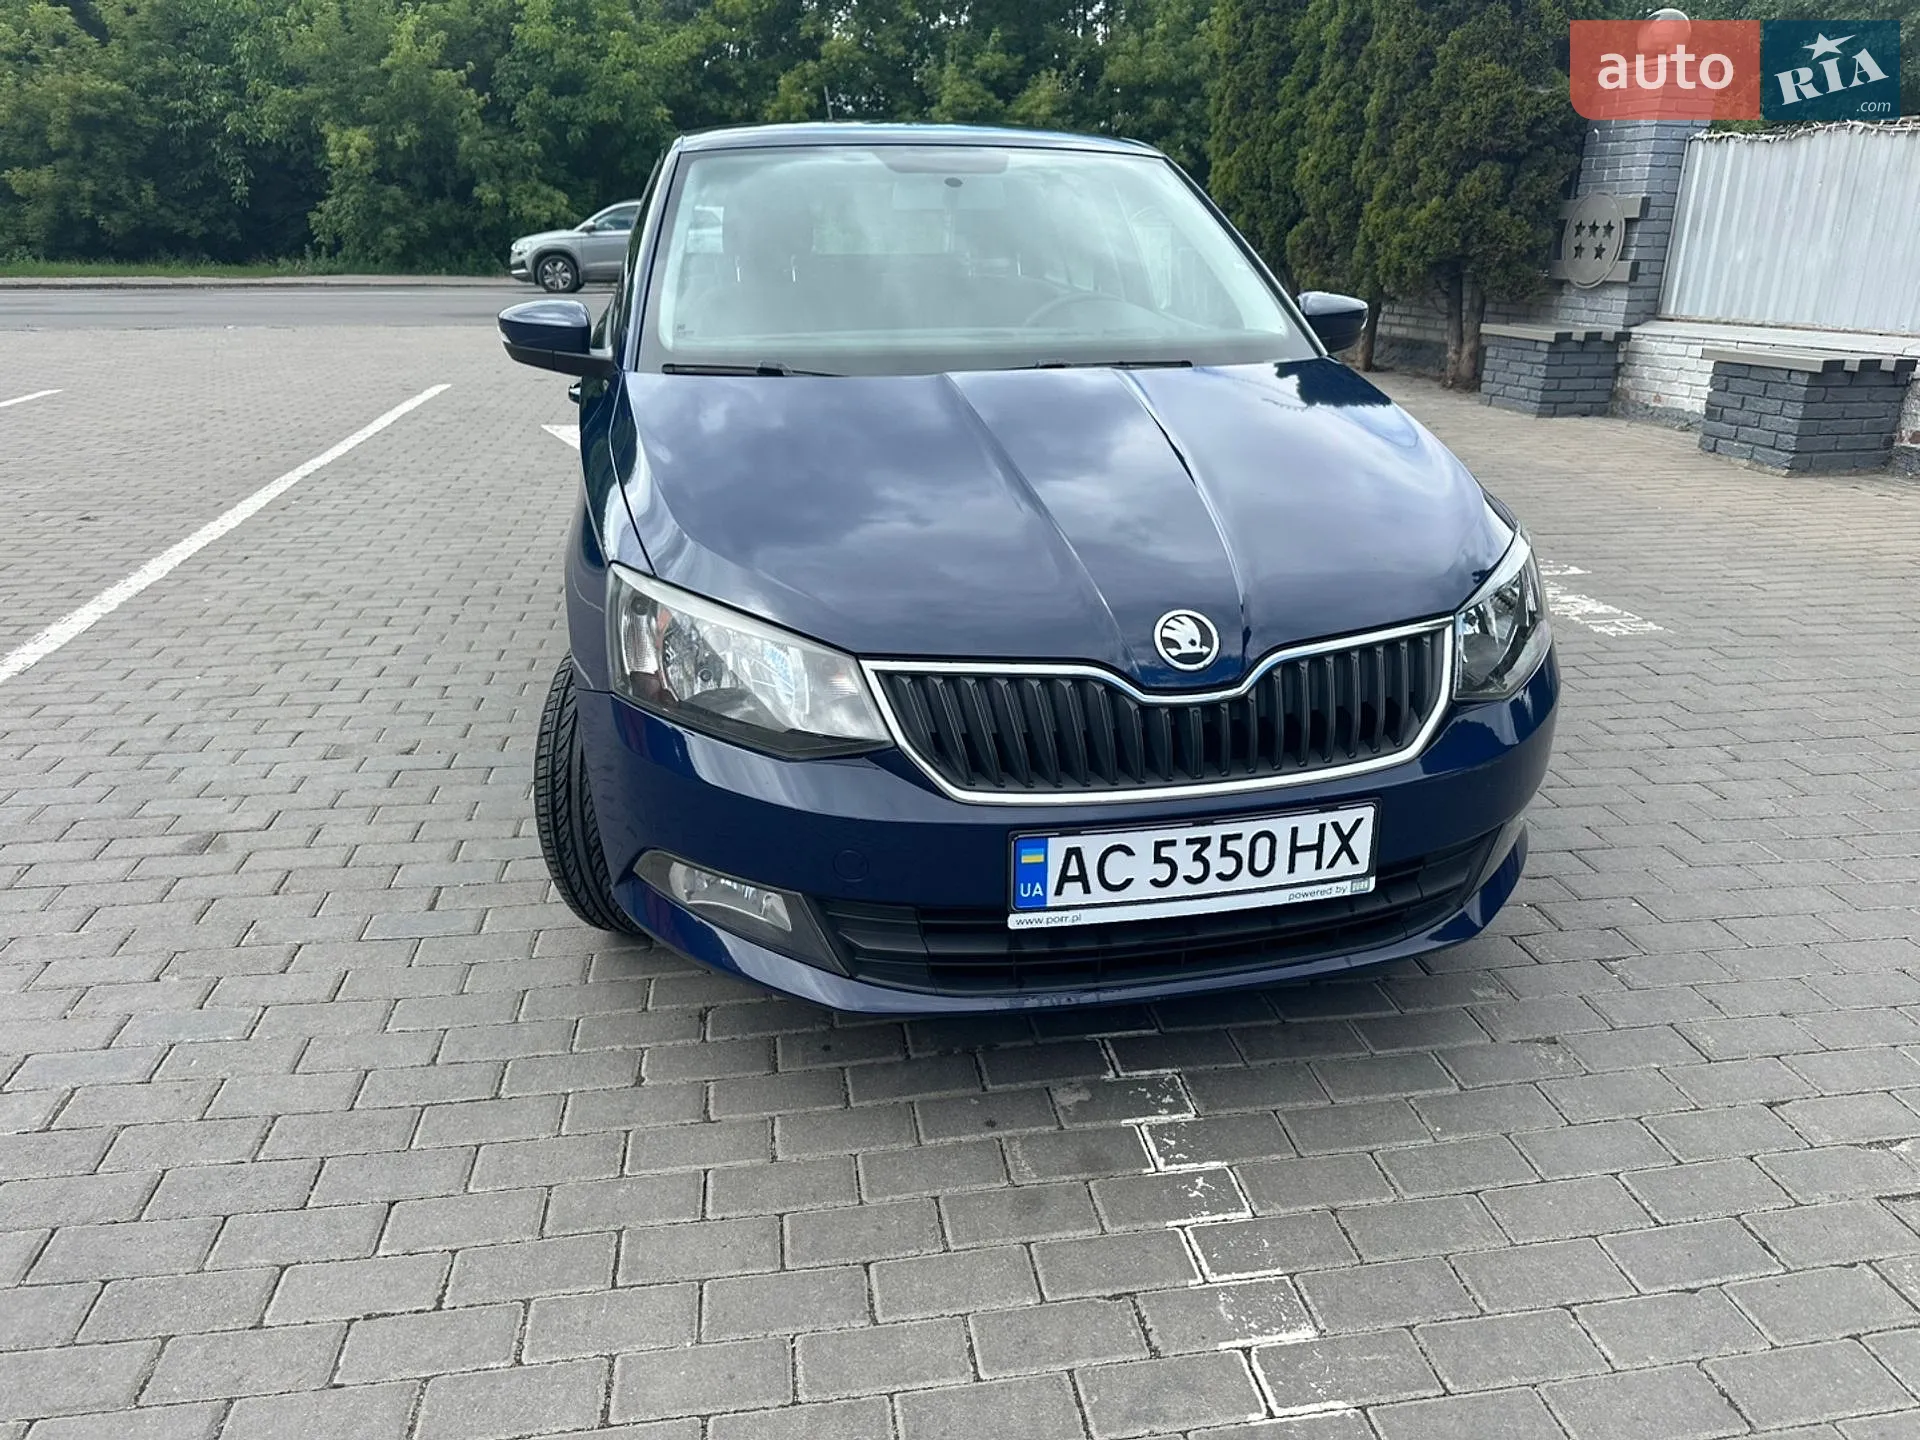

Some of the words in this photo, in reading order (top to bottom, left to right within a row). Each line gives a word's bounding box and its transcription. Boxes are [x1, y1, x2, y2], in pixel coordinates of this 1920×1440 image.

[1054, 843, 1136, 896] AC
[1149, 829, 1277, 888] 5350
[1287, 817, 1364, 874] HX
[1020, 882, 1044, 897] UA
[1288, 885, 1333, 901] powered
[1336, 885, 1348, 895] by
[1015, 912, 1082, 925] www.porr.pl
